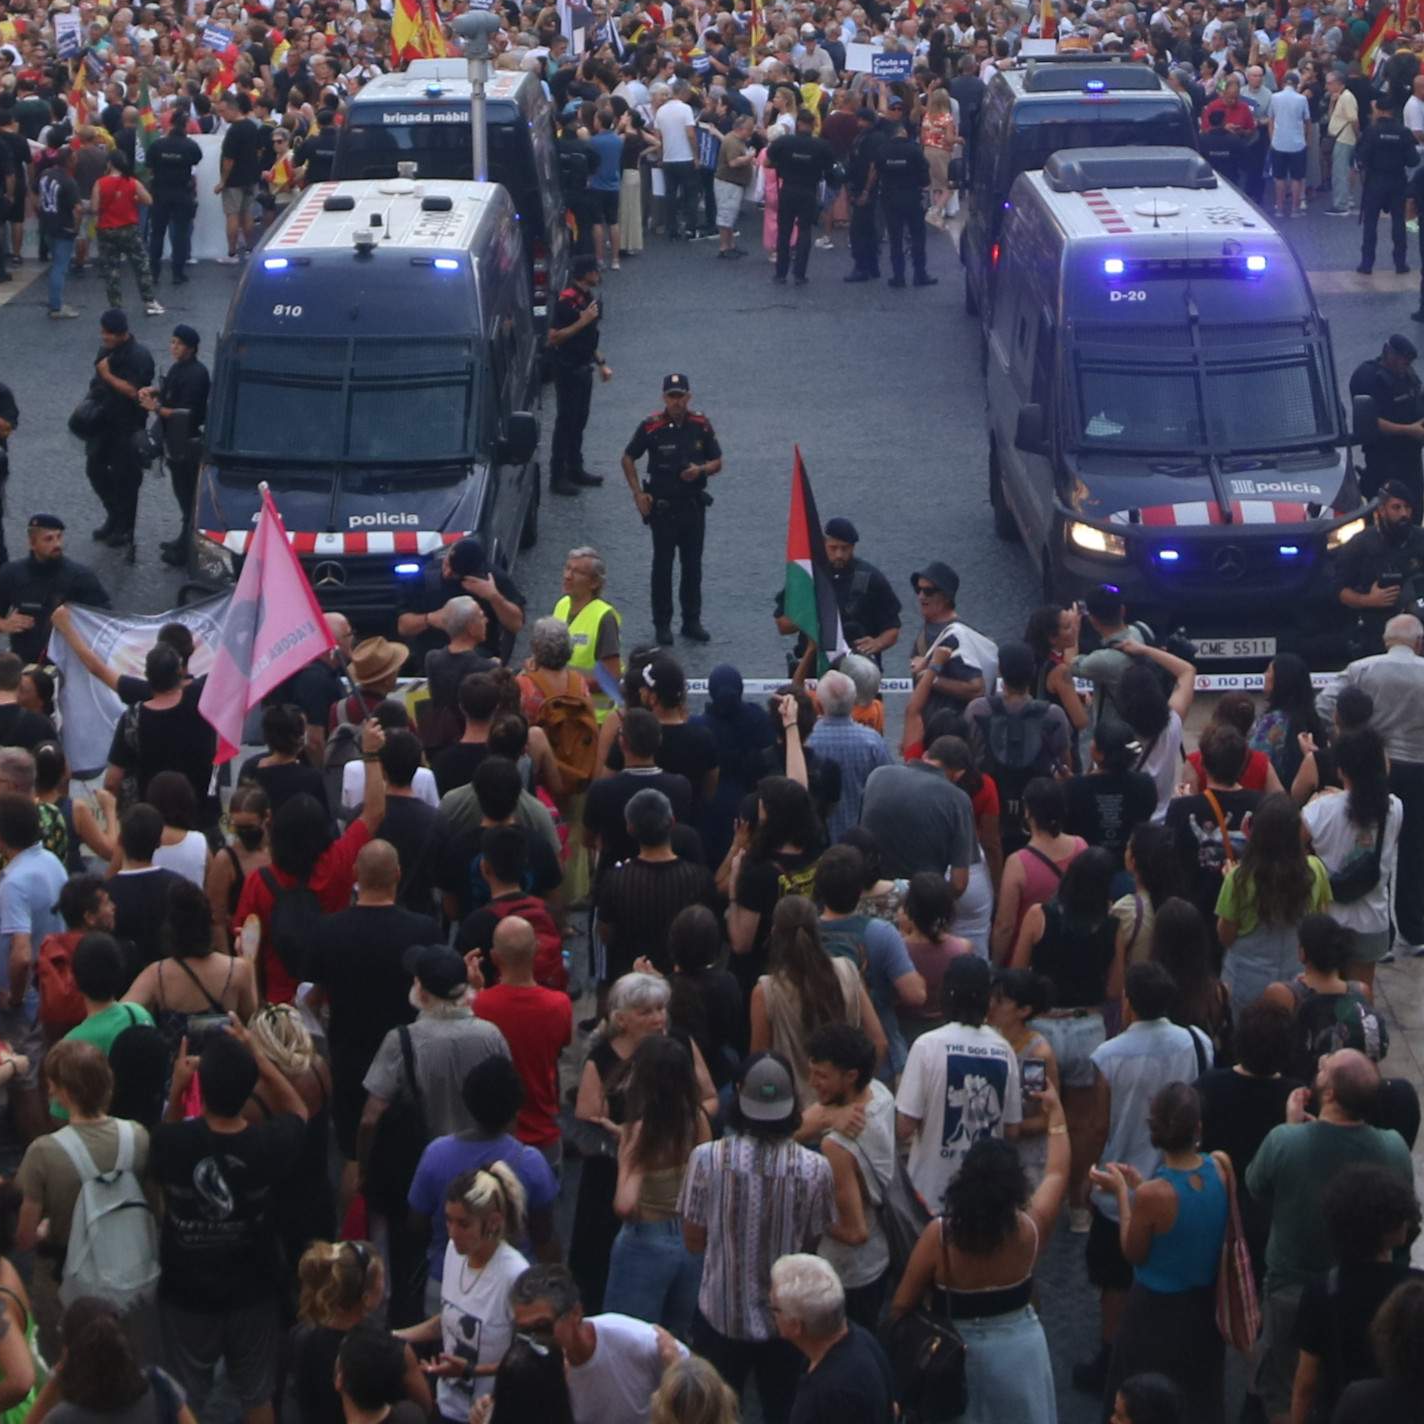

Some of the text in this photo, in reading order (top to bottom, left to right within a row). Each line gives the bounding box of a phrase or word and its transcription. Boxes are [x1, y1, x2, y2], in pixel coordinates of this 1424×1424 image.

[873, 57, 909, 68] Ceuta es
[873, 65, 905, 77] España
[383, 112, 469, 124] brigada mòbil
[1109, 290, 1147, 302] D-20
[273, 304, 303, 317] 810
[1256, 480, 1321, 495] policia
[348, 512, 419, 527] policia
[1199, 640, 1267, 656] CME 5511
[879, 679, 909, 690] seu
[1217, 676, 1239, 687] no
[945, 1044, 965, 1053] THE
[967, 1046, 988, 1055] DOG
